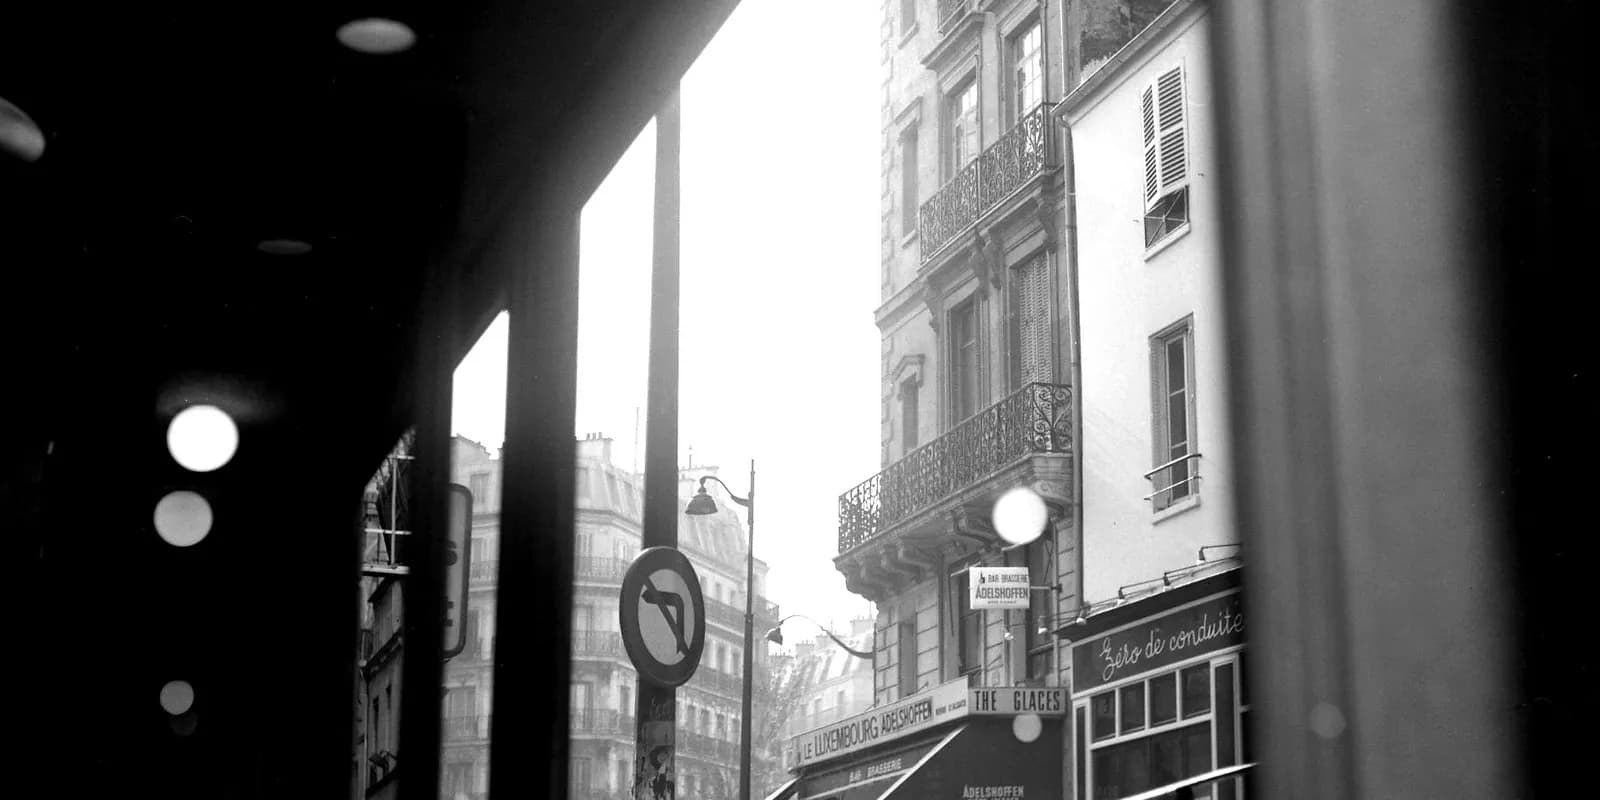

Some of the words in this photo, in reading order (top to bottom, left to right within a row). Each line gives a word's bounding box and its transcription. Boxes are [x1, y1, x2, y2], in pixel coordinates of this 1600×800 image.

[976, 584, 1028, 600] ADELSHOFFEN
[974, 690, 997, 711] THE
[1014, 690, 1060, 711] GLACES
[804, 742, 813, 760] LE
[814, 716, 879, 757] LUXEMBOURG
[880, 699, 933, 735] ADELSHOFFEN
[963, 784, 1025, 799] ADELSHOFFEN
